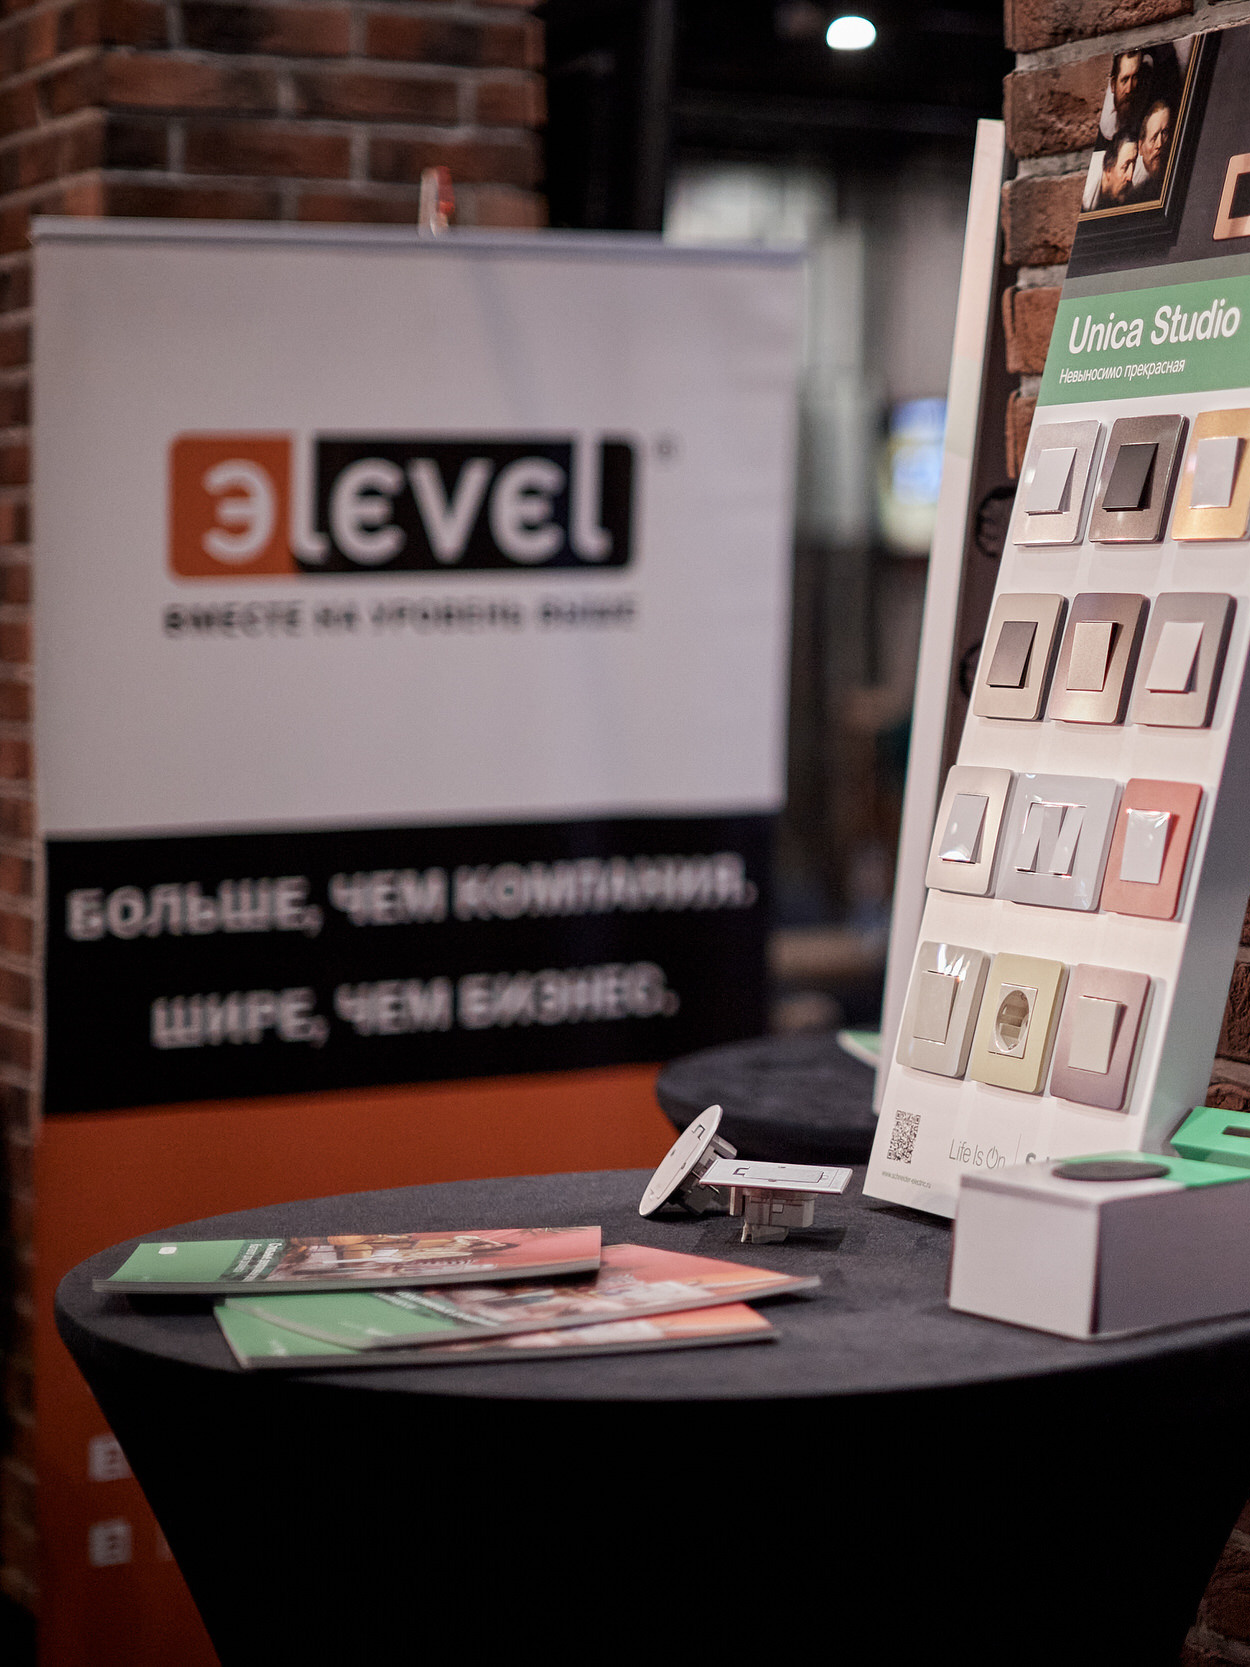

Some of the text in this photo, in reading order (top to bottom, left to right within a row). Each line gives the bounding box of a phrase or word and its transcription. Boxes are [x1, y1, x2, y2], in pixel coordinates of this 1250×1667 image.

[1068, 298, 1241, 354] Unica Studio
[1059, 358, 1186, 385] Невыносимо прекрасная
[66, 876, 323, 941] БОЛЬШЕ,
[328, 866, 449, 927] ЧЕМ
[151, 961, 681, 1050] ШИРЕ, ЧЕМ БИЗНЕС.
[949, 1138, 971, 1164] Life
[972, 1143, 984, 1167] Is
[986, 1145, 1006, 1170] On
